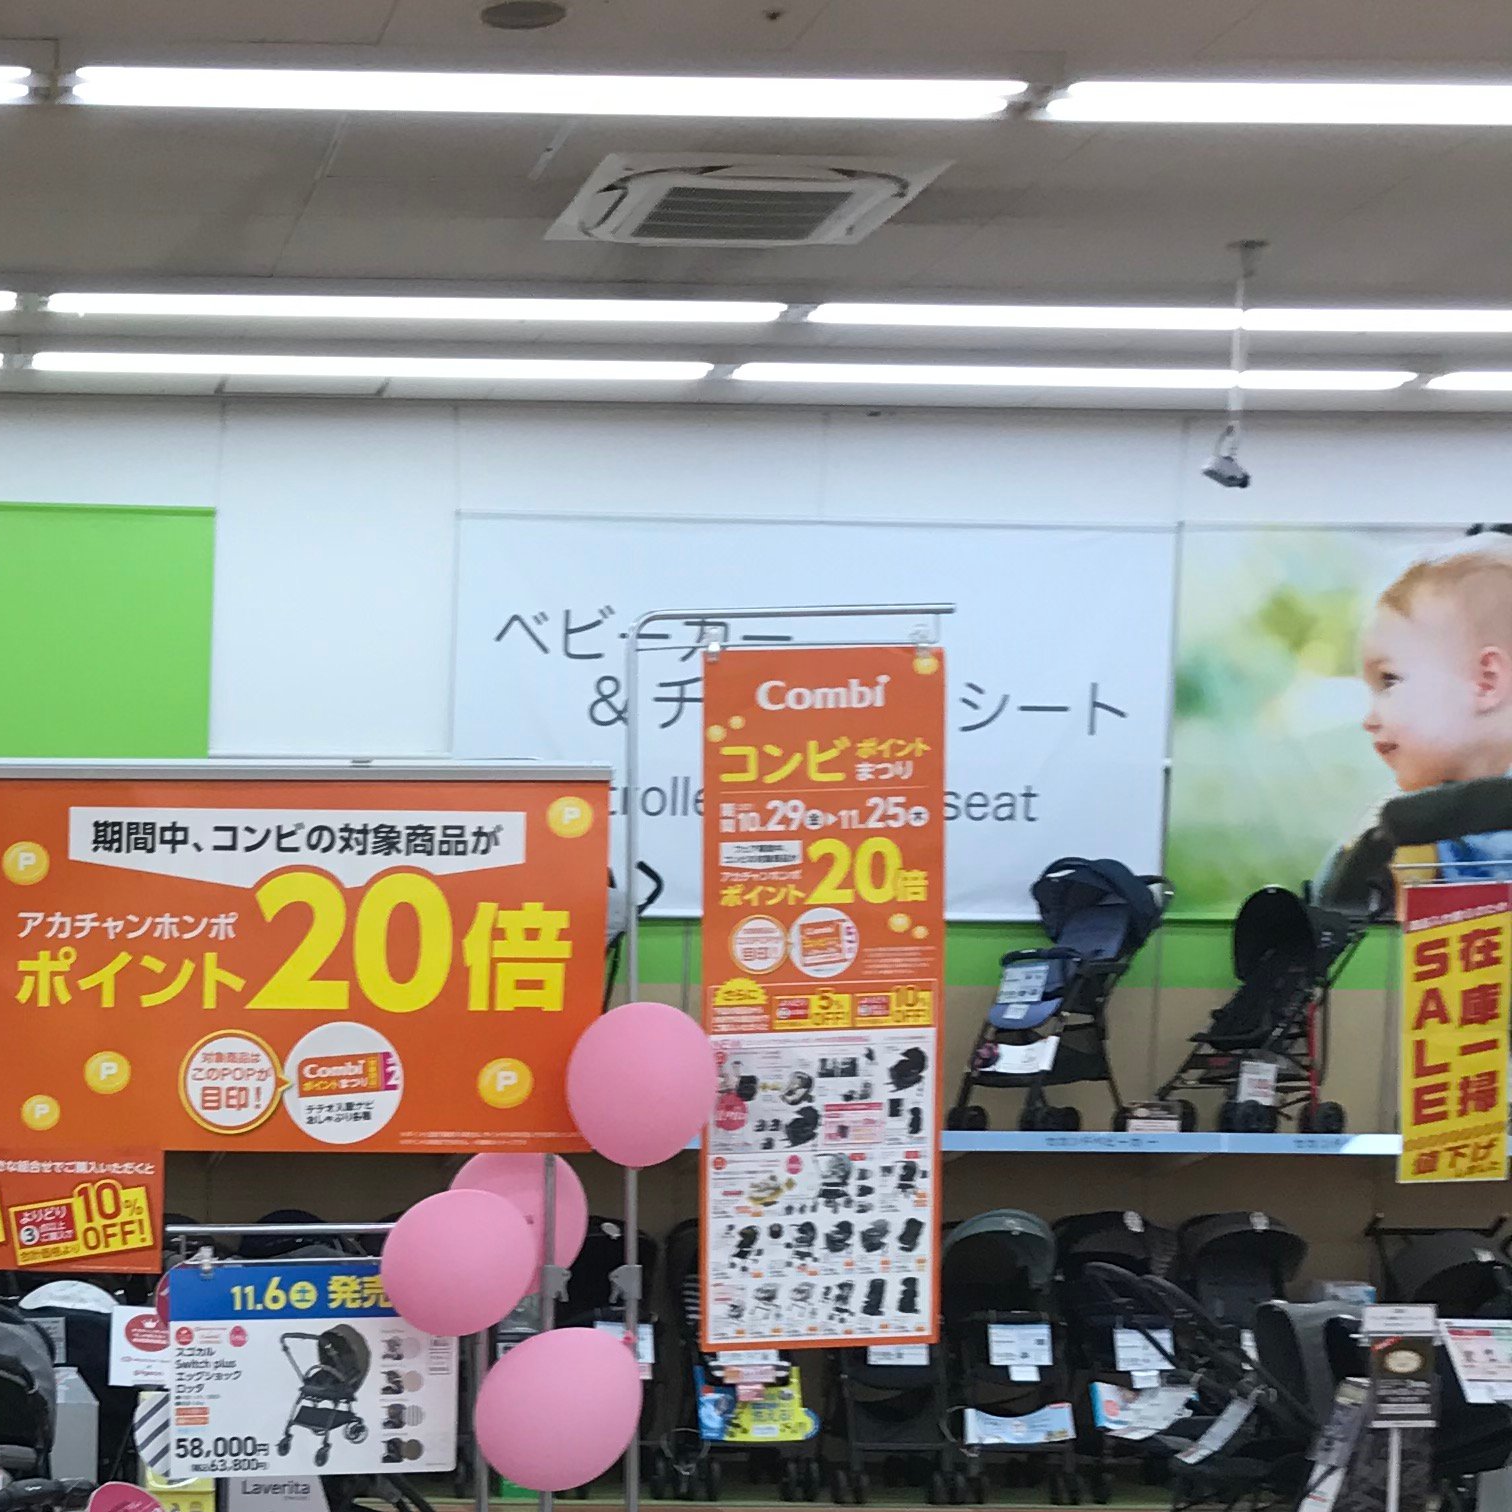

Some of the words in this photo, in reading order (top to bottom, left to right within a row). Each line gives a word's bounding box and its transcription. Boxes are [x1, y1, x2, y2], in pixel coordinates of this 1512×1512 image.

[755, 675, 891, 711] Combi
[719, 737, 851, 784] コンビ
[856, 737, 932, 758] ポイント
[855, 761, 914, 782] まつり
[92, 820, 503, 857] 期間中、コンビの対象商品が
[17, 912, 238, 942] アカチャンホンポ
[1412, 936, 1451, 1127] SALE
[1457, 926, 1503, 1118] 在庫一掃
[192, 1067, 273, 1082] このPOPが
[303, 1060, 365, 1079] Combi
[20, 1206, 67, 1224] よりどり
[175, 1436, 270, 1459] 58,000円
